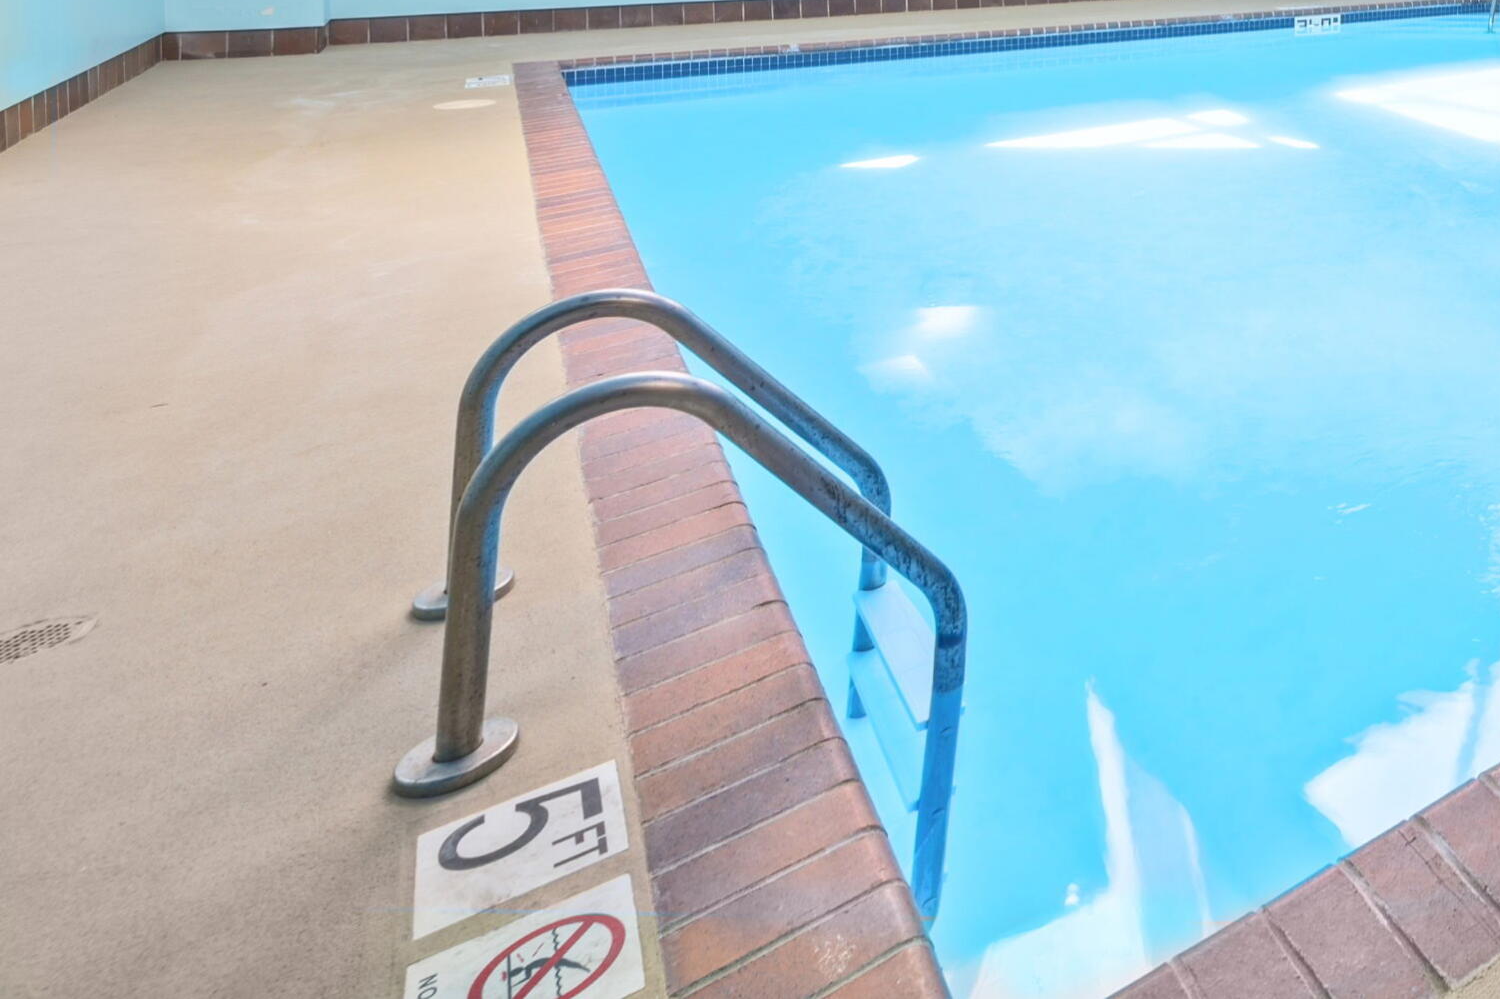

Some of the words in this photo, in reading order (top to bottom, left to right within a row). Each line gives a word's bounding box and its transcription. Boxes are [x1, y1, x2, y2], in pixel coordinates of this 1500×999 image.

[438, 777, 603, 871] 5
[551, 821, 609, 869] FT
[417, 973, 438, 999] NO
